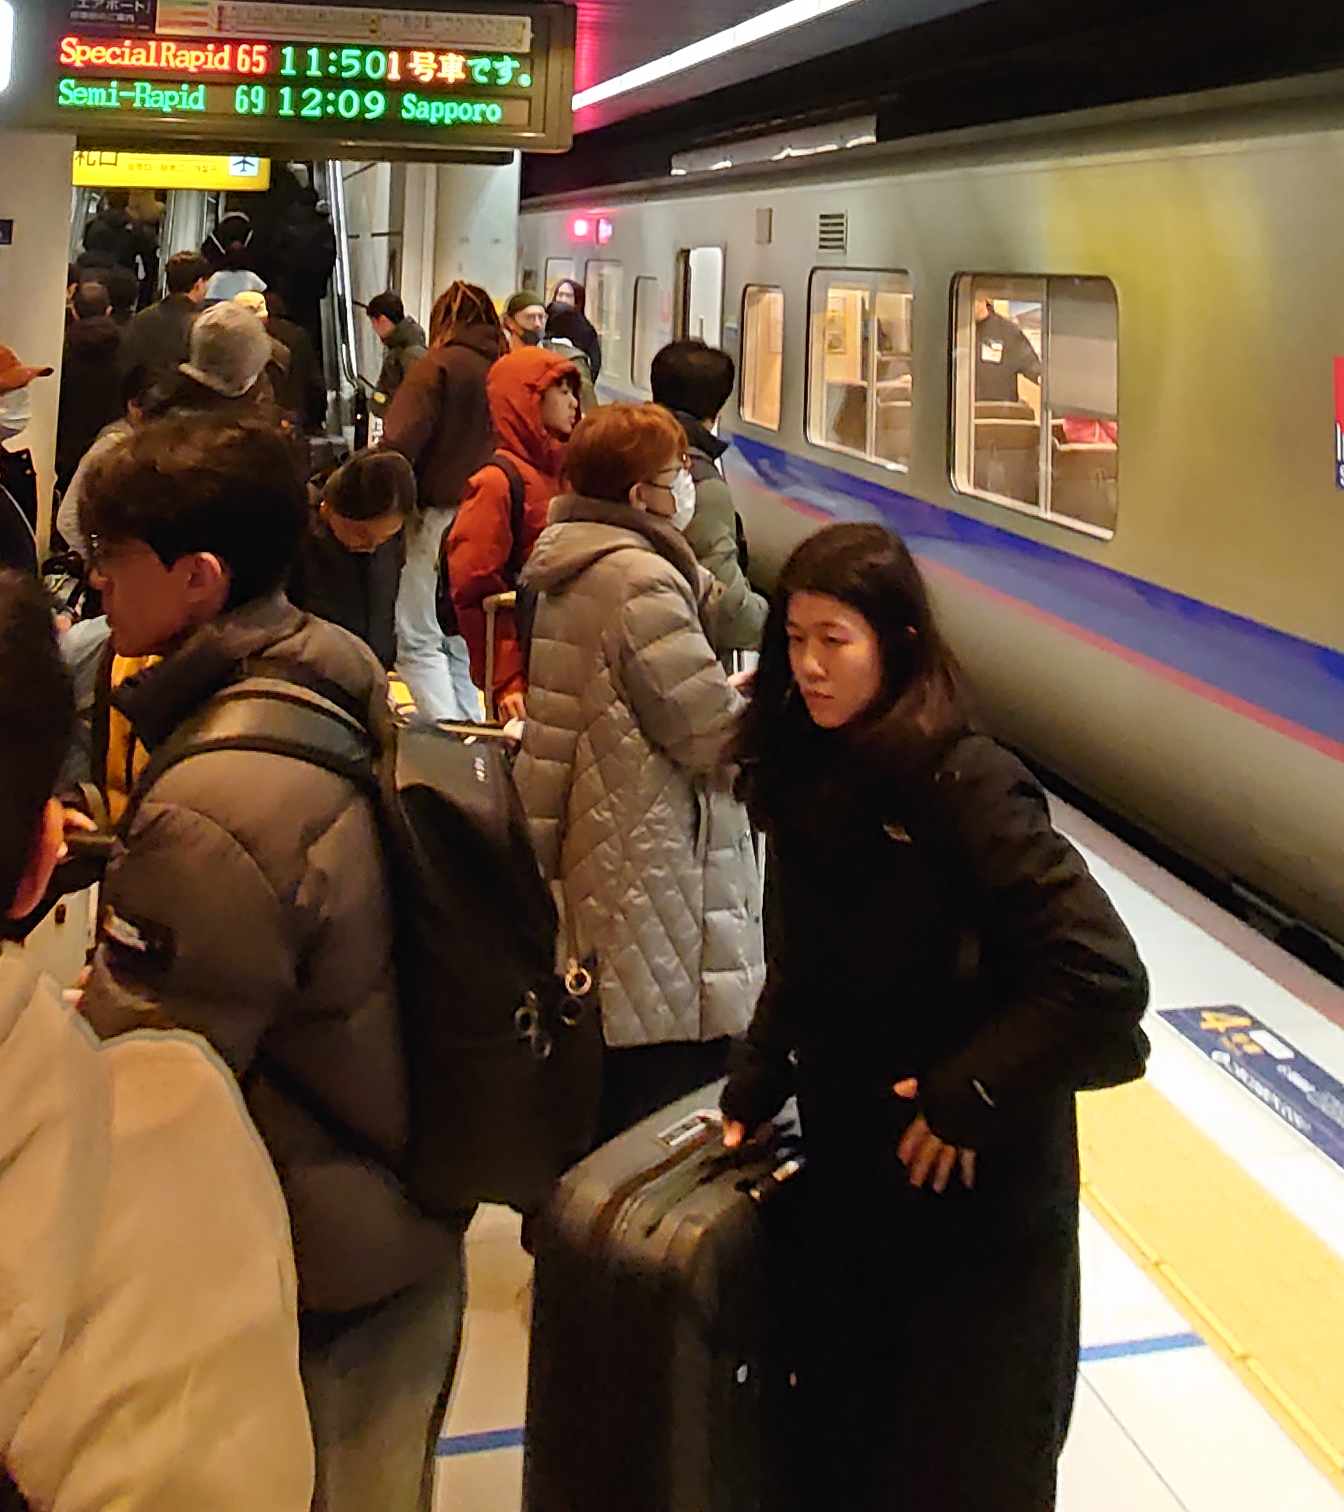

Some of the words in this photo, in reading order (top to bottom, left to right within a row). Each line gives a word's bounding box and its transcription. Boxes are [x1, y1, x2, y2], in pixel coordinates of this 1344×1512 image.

[236, 44, 269, 75] 65
[280, 46, 386, 80] 11:50
[58, 78, 205, 113] Semi-Rapid
[235, 85, 267, 115] 69
[278, 87, 386, 120] 12:09
[401, 93, 503, 125] Sapporo
